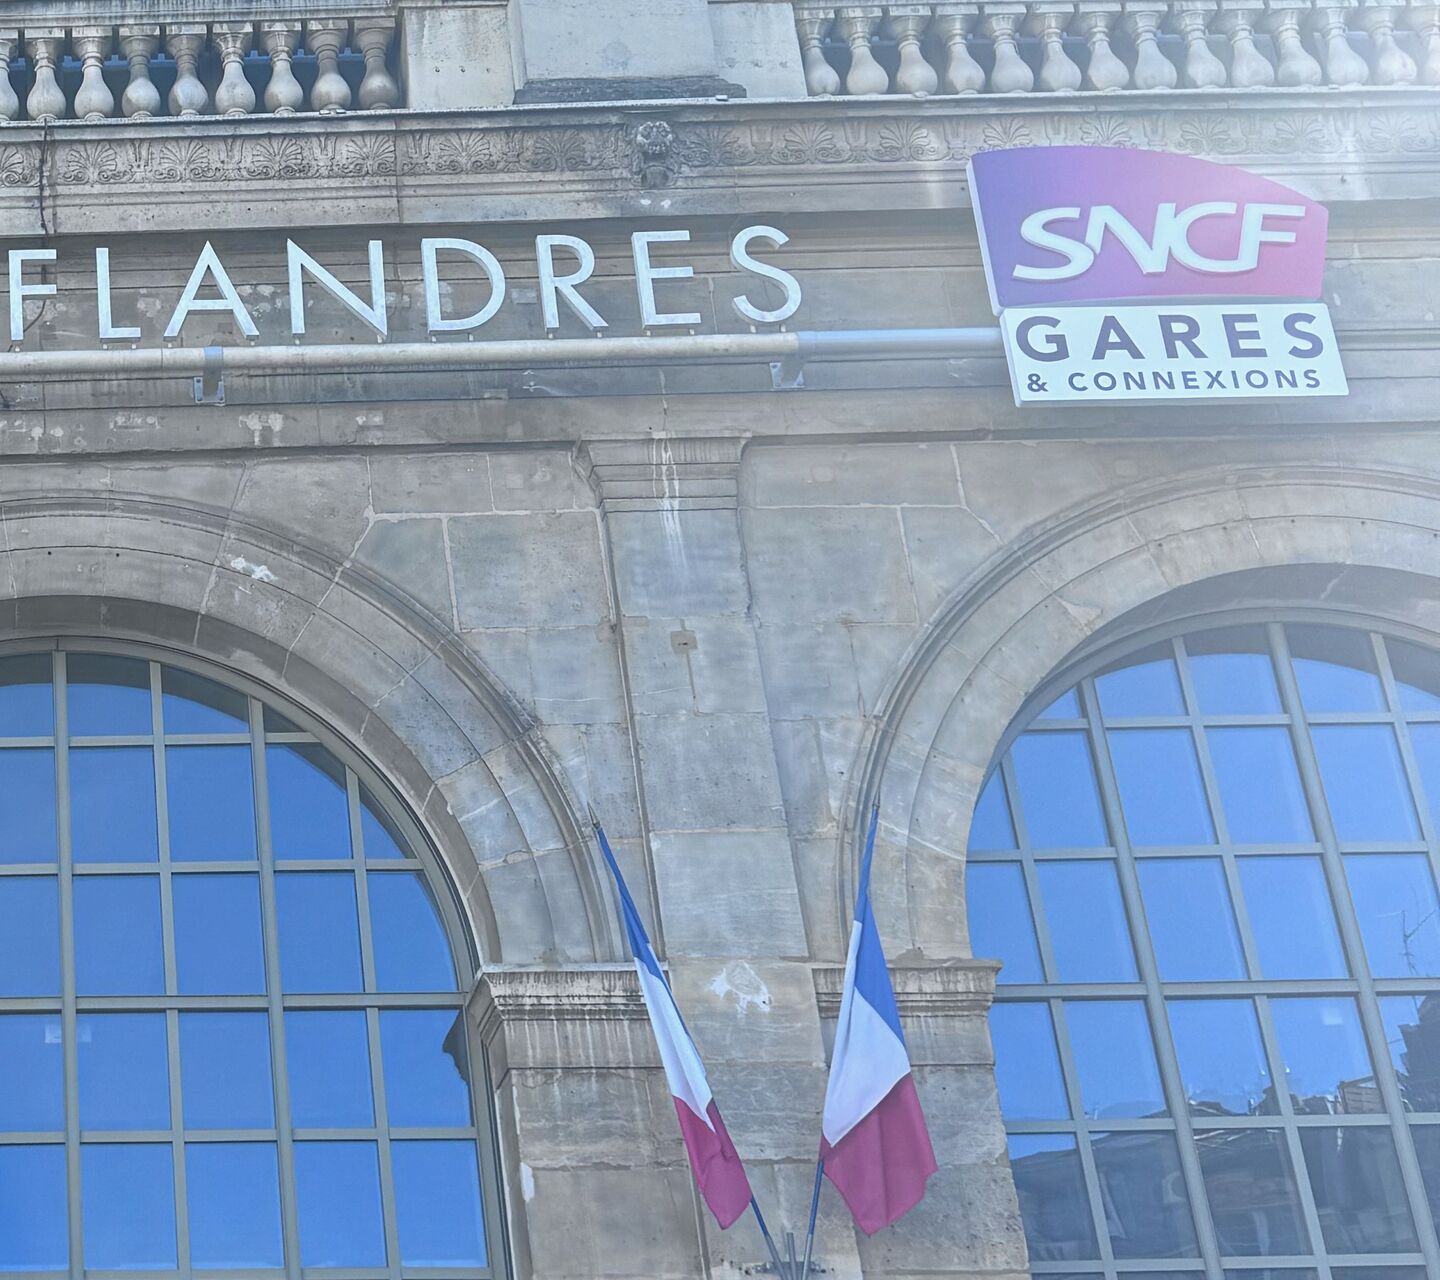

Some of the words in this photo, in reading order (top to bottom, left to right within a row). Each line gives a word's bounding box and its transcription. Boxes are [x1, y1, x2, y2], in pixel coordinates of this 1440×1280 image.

[1012, 202, 1306, 281] SNCF
[8, 225, 803, 342] FLANDRES
[1015, 312, 1324, 363] GARES
[1026, 372, 1049, 393] &
[1068, 369, 1321, 392] CONNEXIONS
